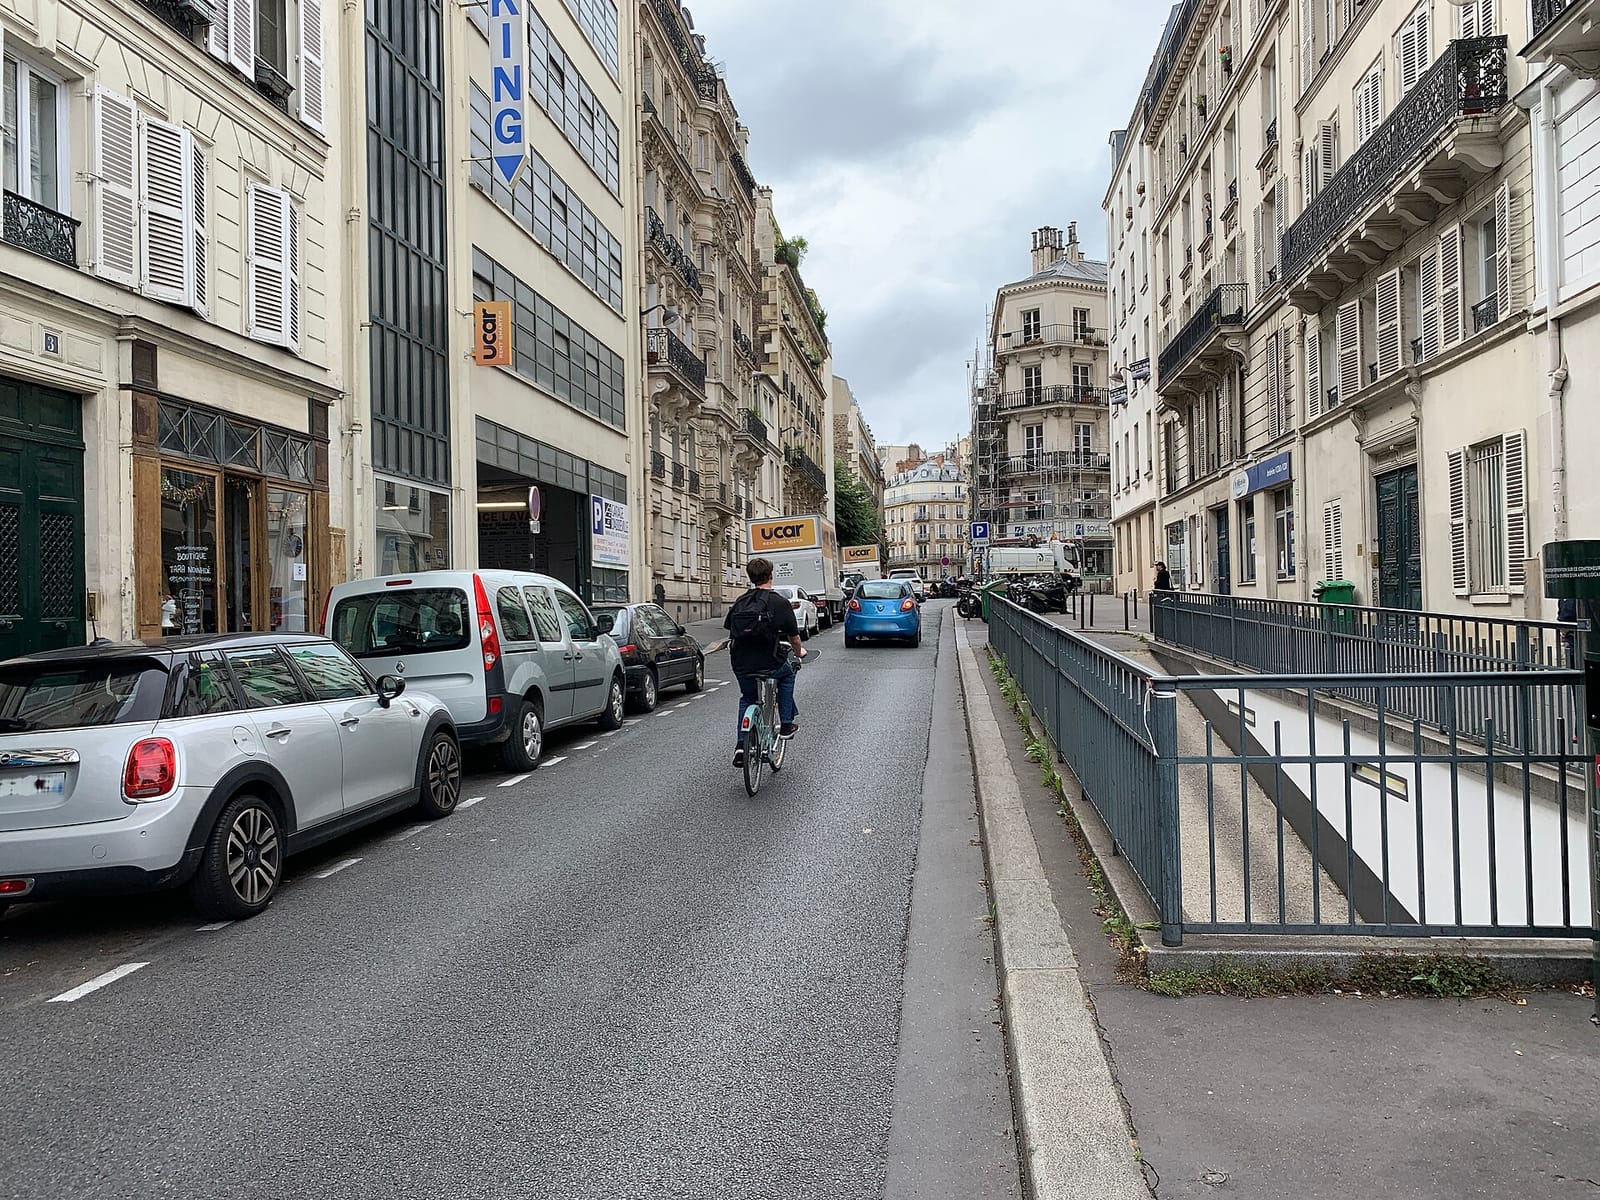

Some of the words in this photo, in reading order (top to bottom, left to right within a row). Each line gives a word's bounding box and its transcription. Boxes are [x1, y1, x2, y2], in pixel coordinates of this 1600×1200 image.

[482, 308, 497, 360] ucar
[47, 336, 54, 351] 3
[594, 501, 602, 530] P
[761, 524, 804, 540] ucar
[976, 526, 984, 537] P
[176, 552, 207, 560] BOUTIQUE
